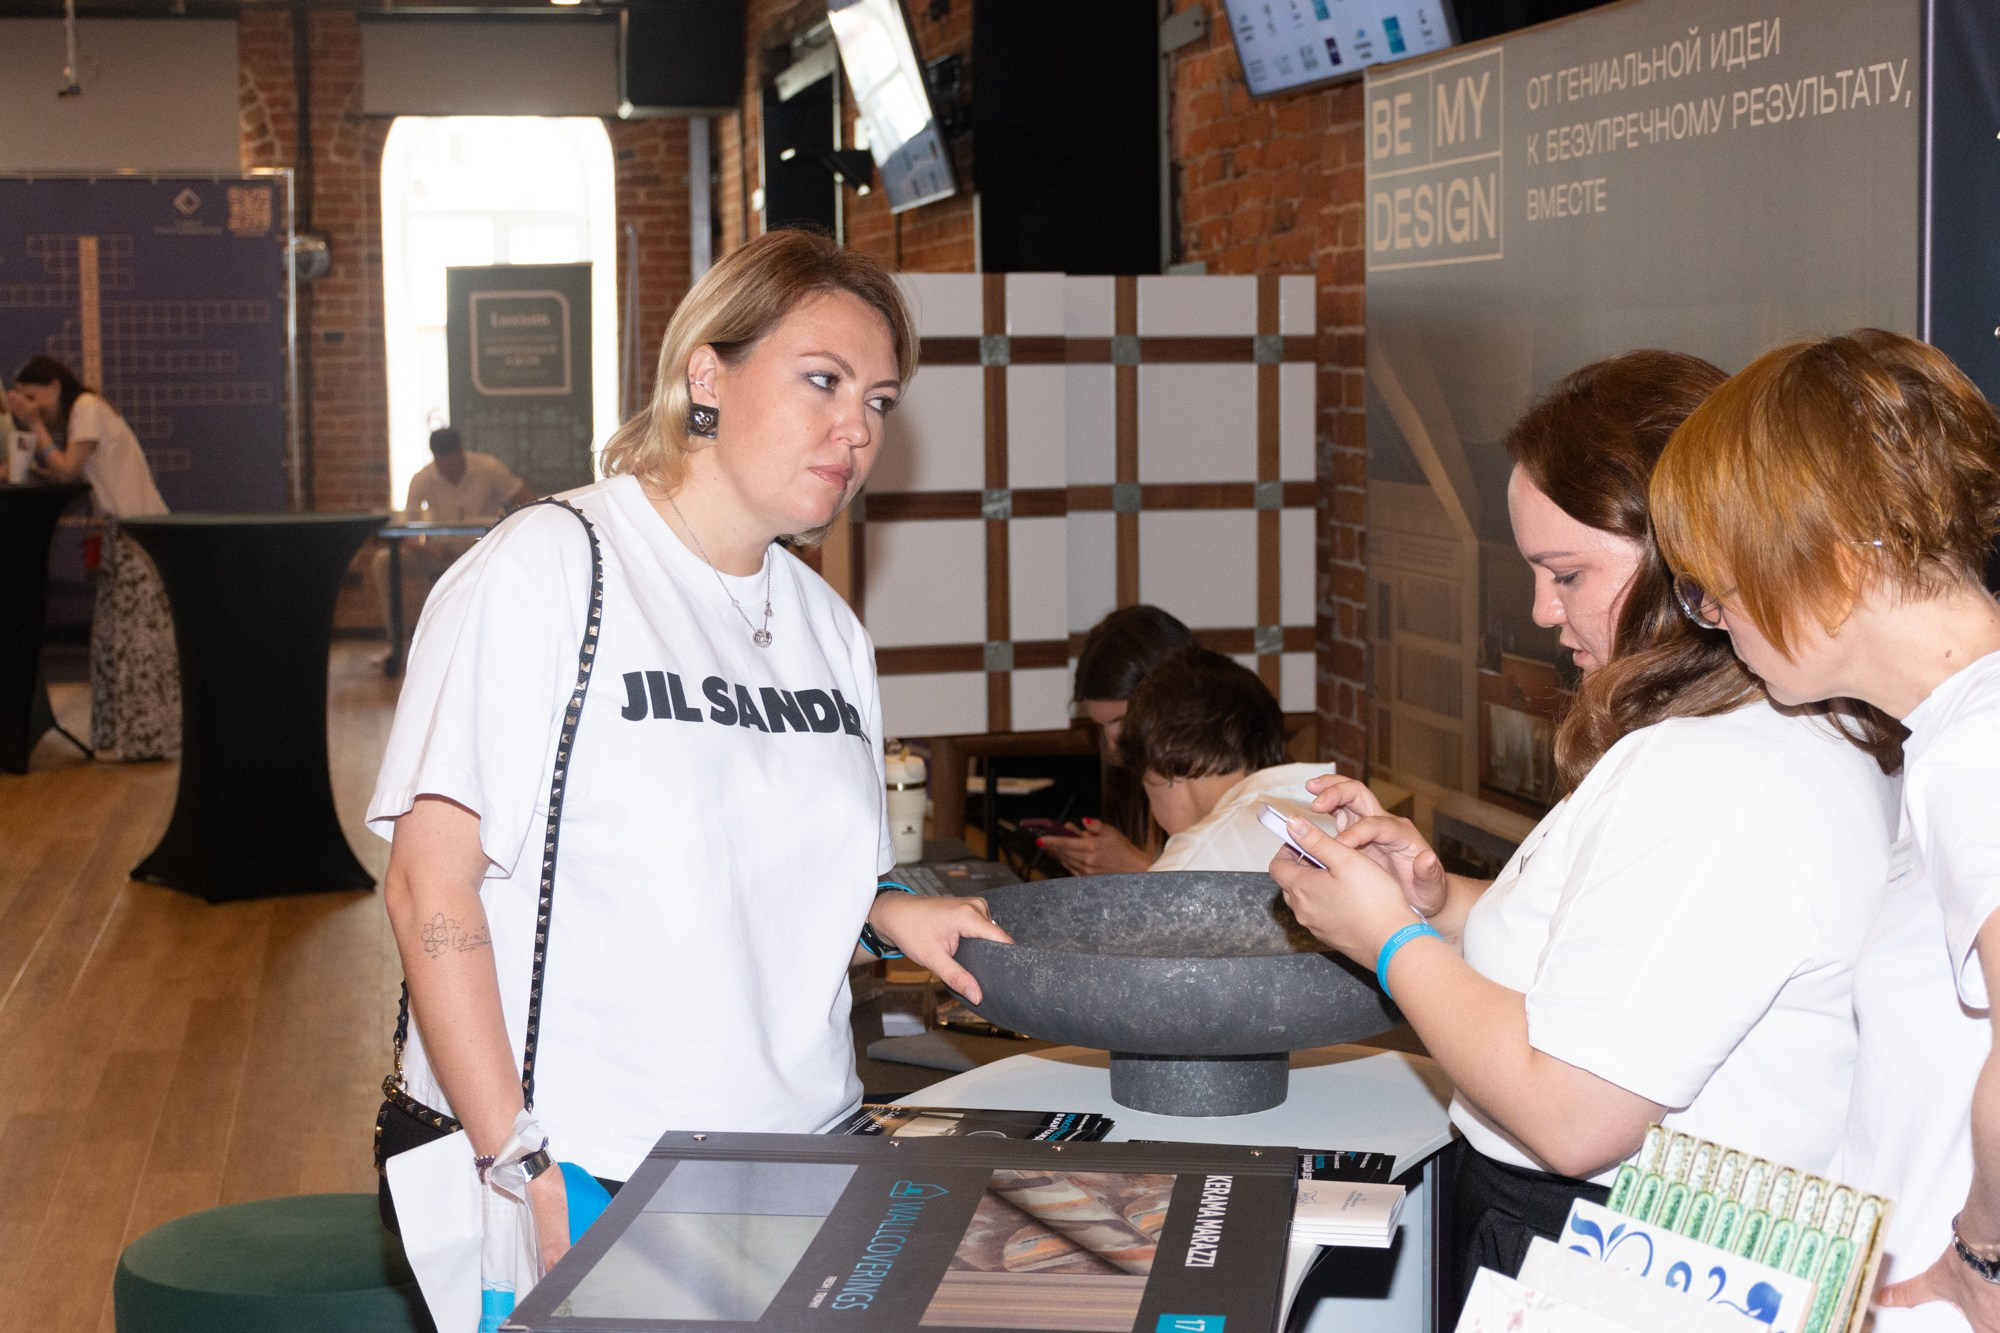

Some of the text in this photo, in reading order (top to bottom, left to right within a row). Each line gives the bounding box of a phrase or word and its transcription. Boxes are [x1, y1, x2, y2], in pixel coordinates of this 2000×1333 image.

[1526, 16, 1781, 110] ОТ ГЕНИАЛЬНОЙ ИДЕИ
[1371, 71, 1491, 161] BE MY
[1526, 58, 1912, 166] К БЕЗУПРЕЧНОМУ РЕЗУЛЬТАТУ,
[1372, 173, 1497, 252] DESIGN
[1526, 178, 1608, 221] ВМЕСТЕ
[621, 670, 704, 722] JIL
[831, 1201, 925, 1310] WALLCOVERINGS
[1185, 1175, 1233, 1267] KERAMA MARAZZI
